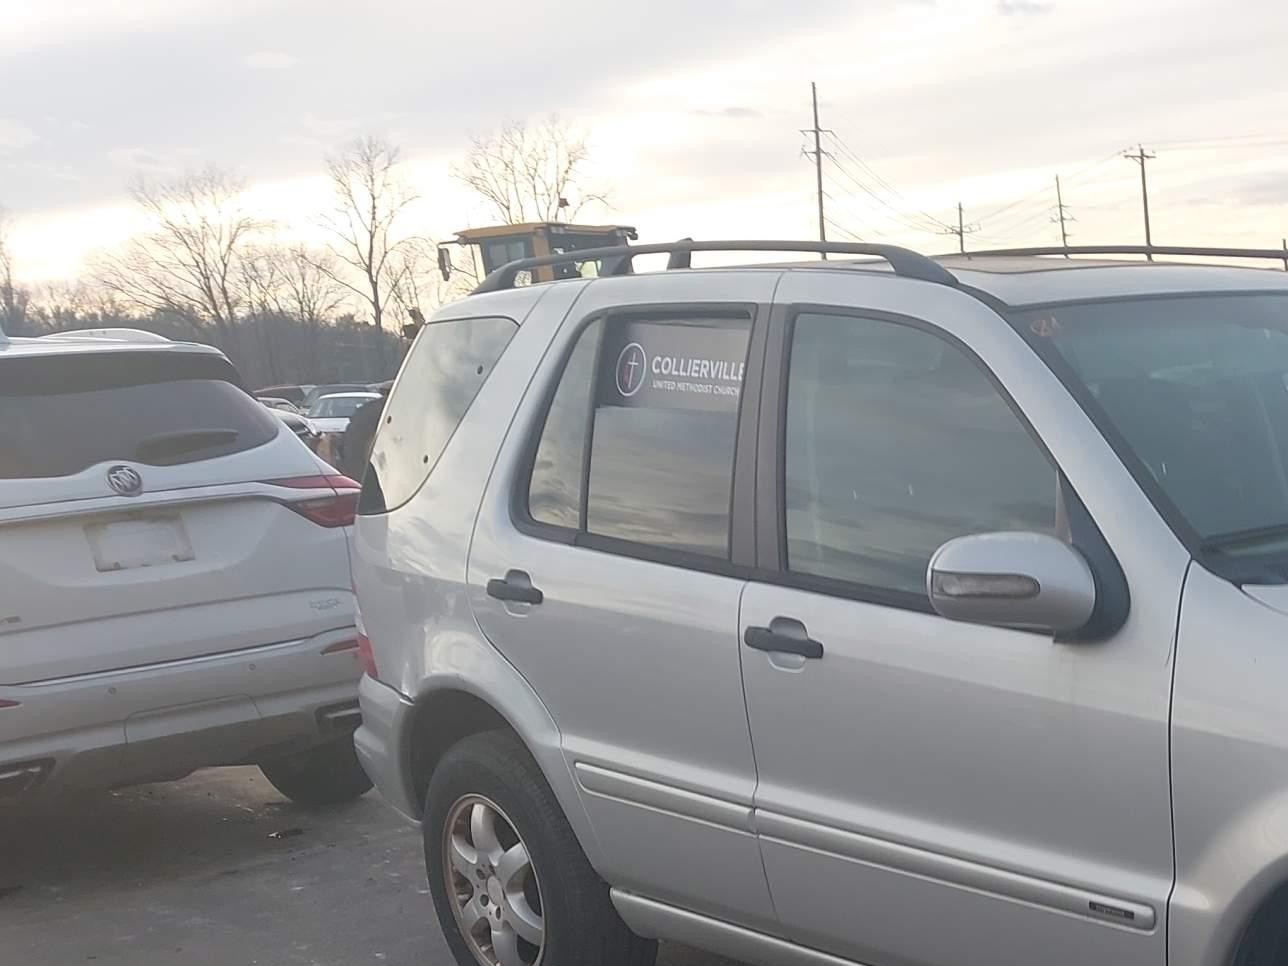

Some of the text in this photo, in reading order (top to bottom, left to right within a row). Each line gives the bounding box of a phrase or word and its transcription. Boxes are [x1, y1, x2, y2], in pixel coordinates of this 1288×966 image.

[652, 355, 745, 381] COLLIERVILLE
[653, 379, 740, 397] UNITED METHODIST CHURCH
